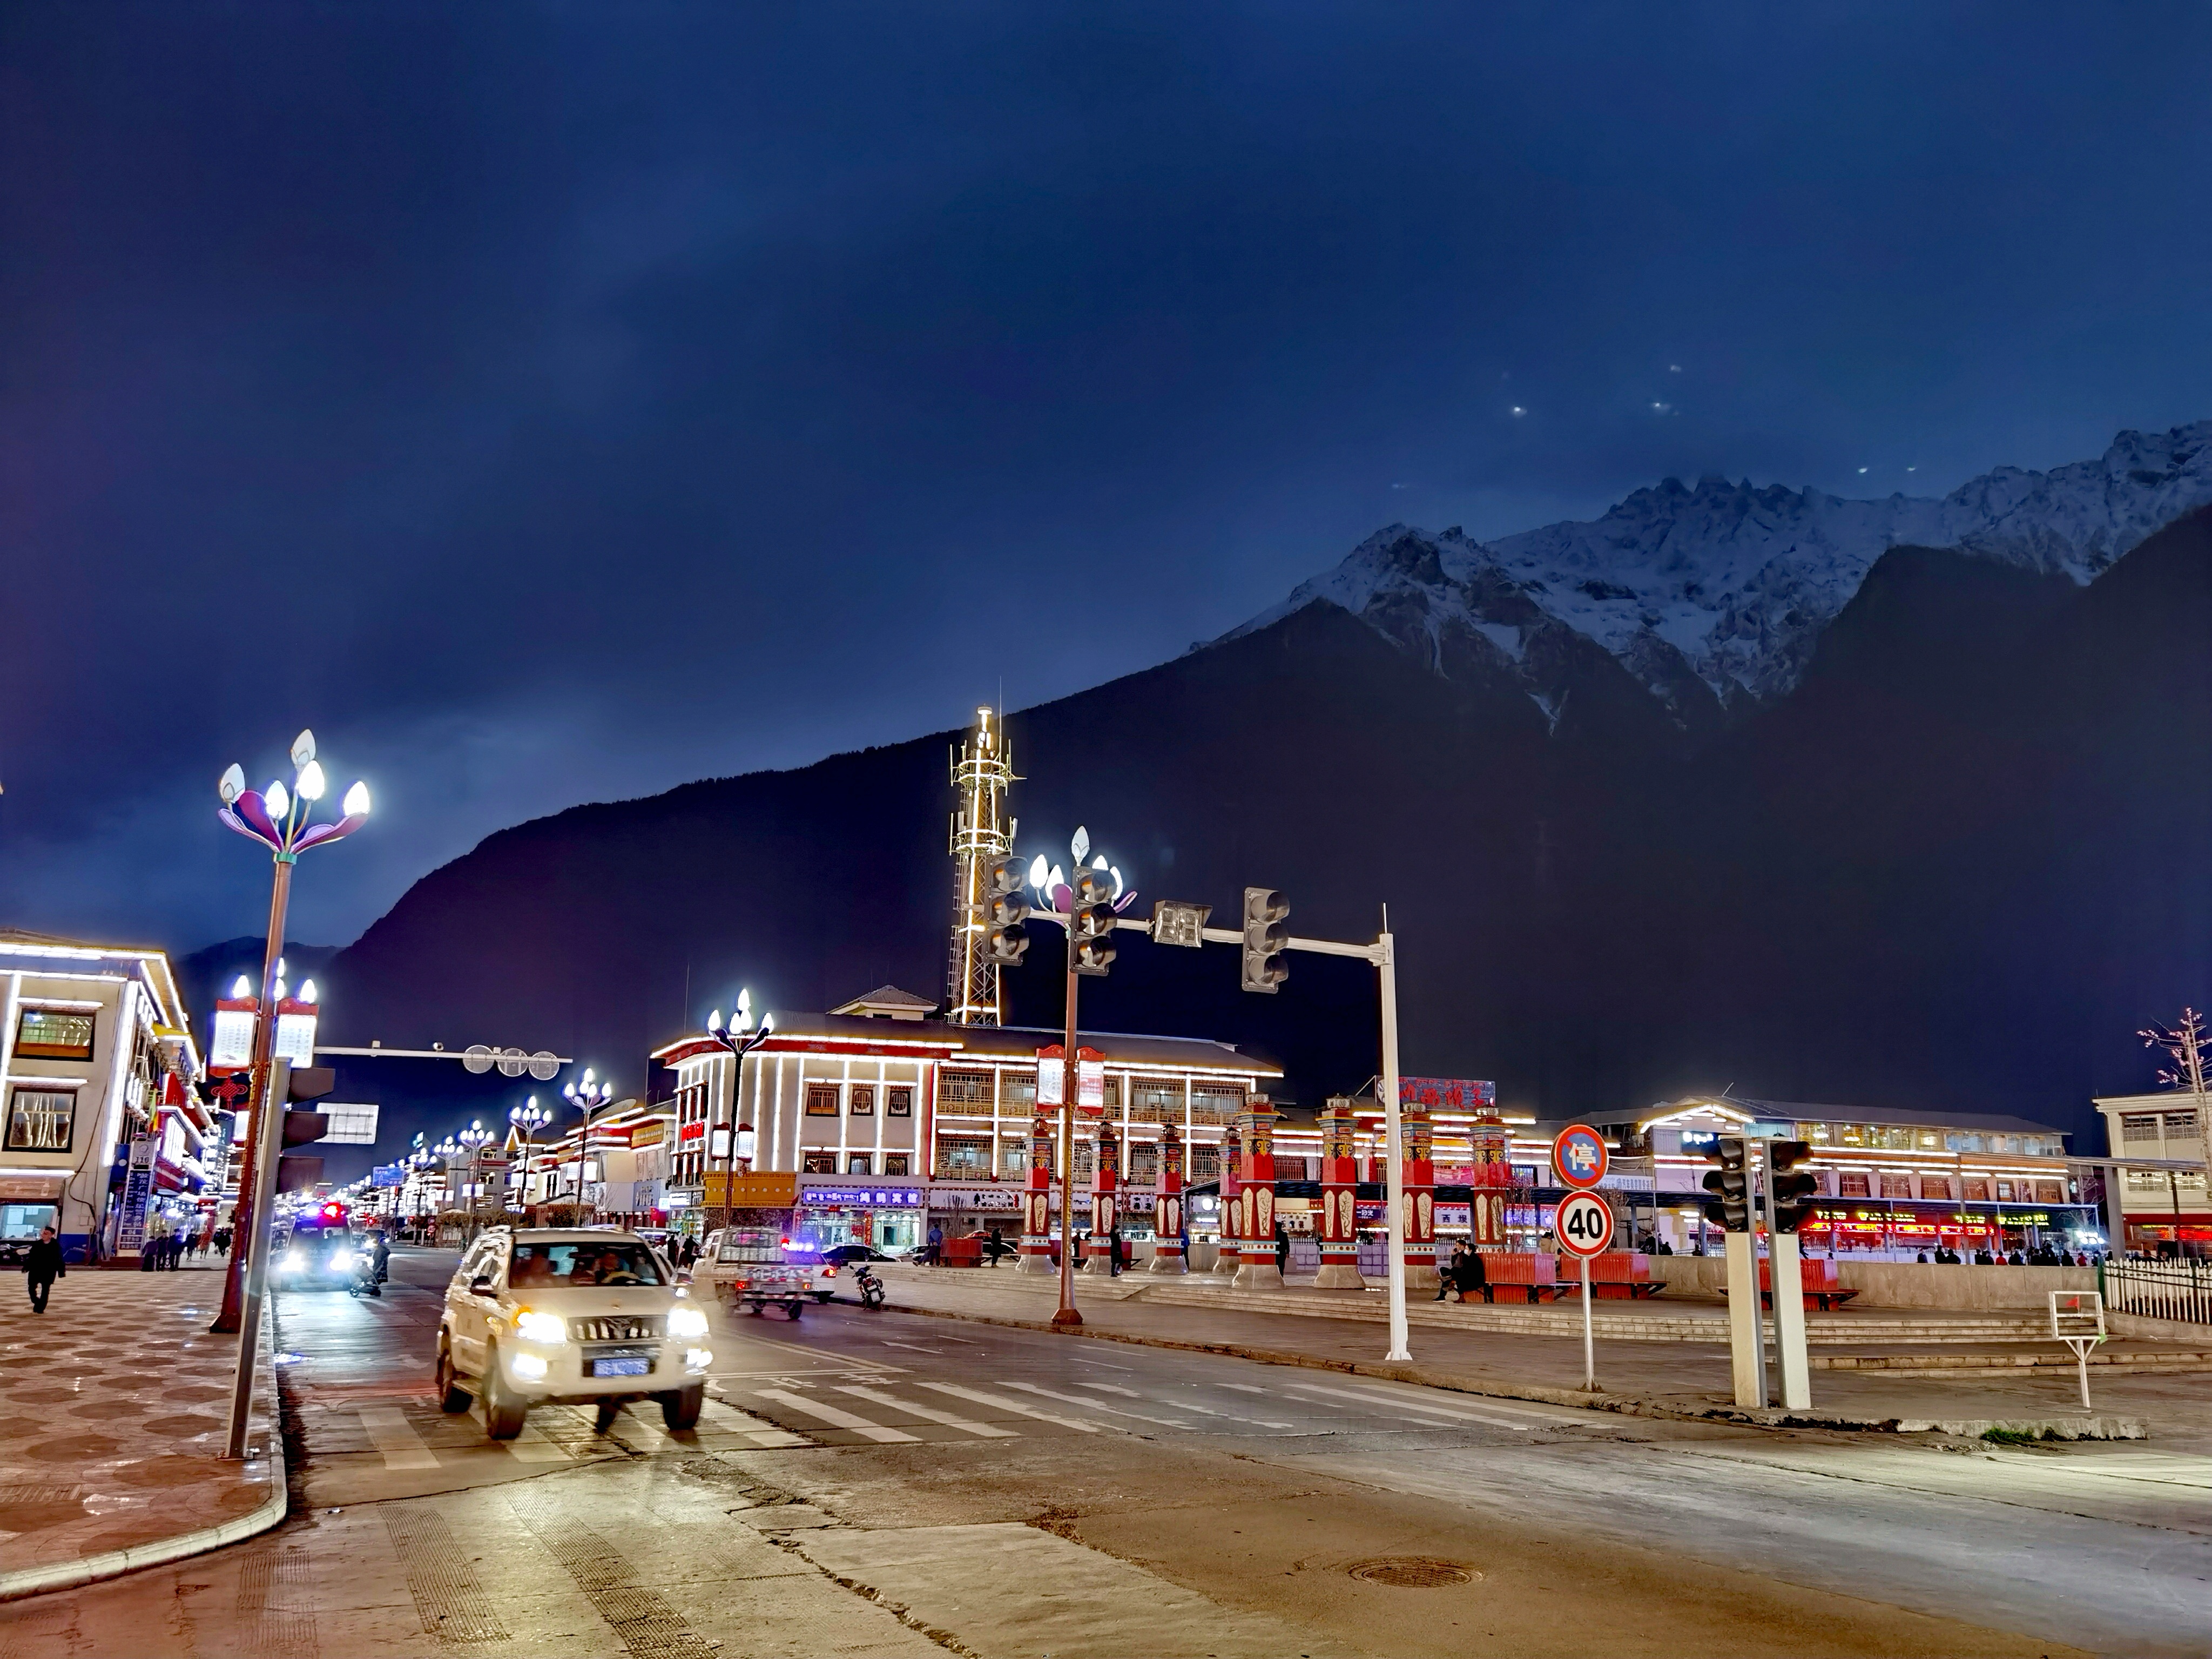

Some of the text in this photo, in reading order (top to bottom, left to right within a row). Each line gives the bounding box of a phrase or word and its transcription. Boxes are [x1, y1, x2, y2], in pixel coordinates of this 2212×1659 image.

[1568, 1143, 1596, 1171] 停
[1441, 1214, 1468, 1223] 西坝
[1568, 1208, 1603, 1239] 40
